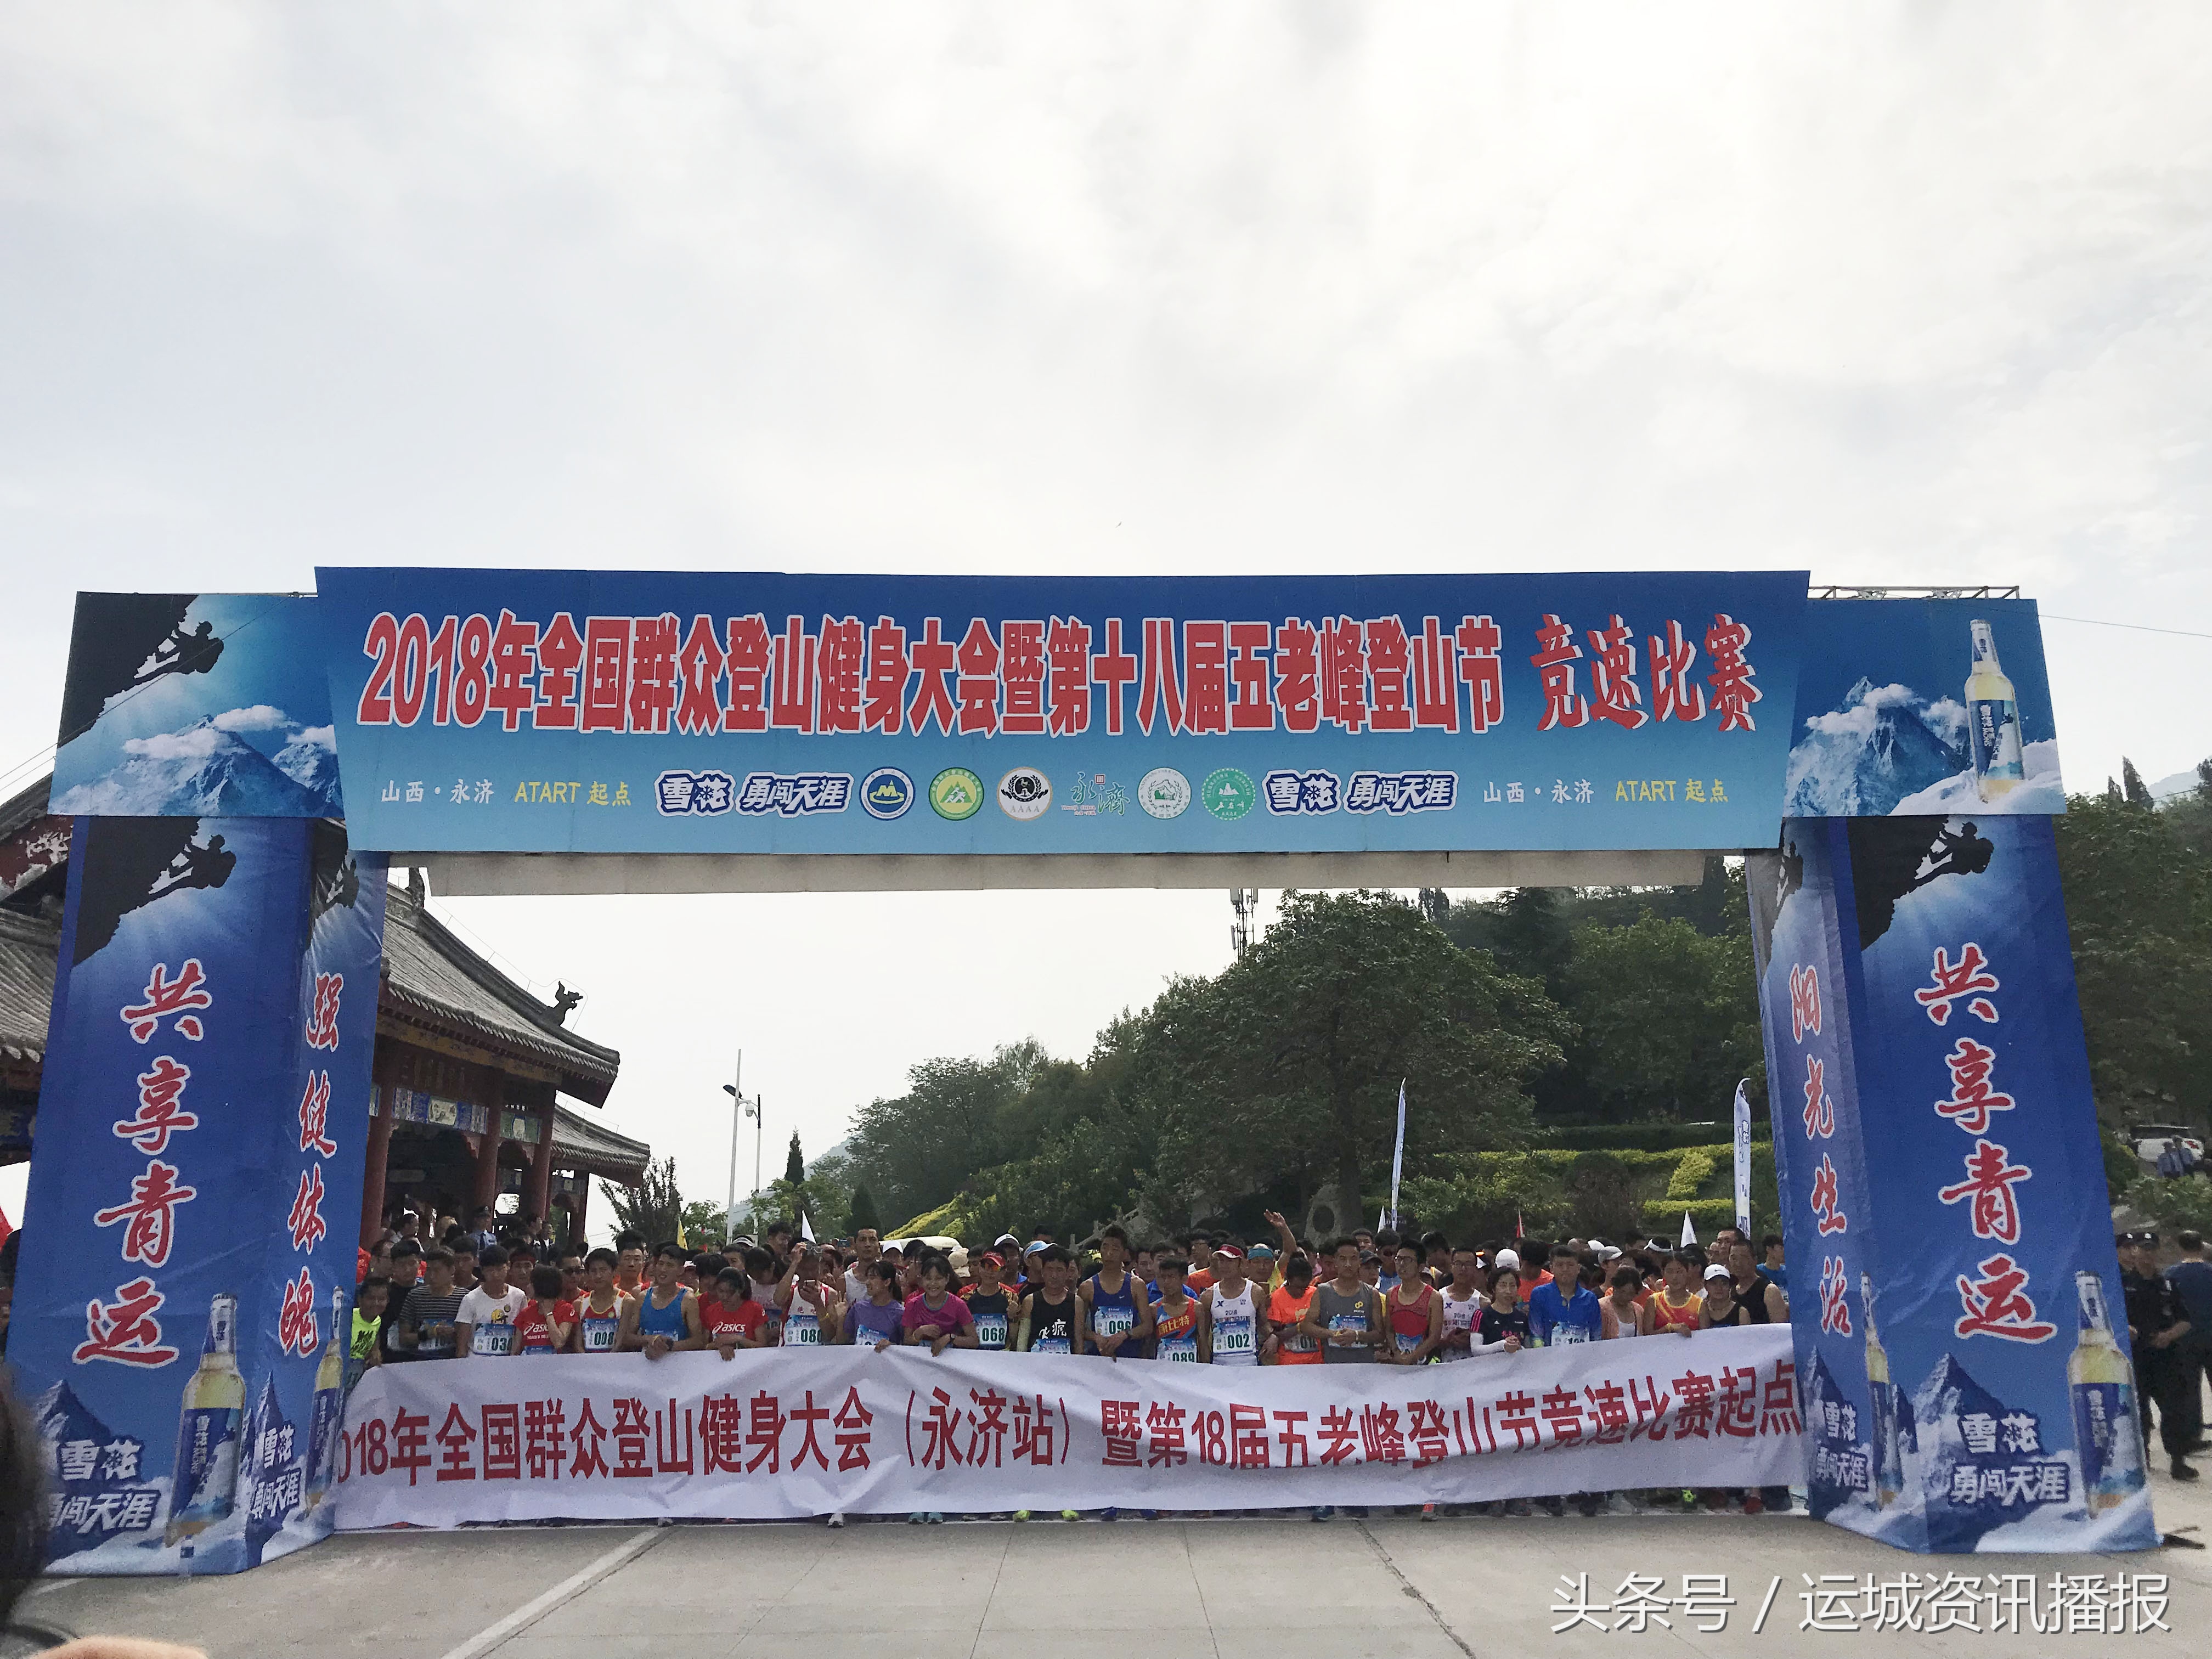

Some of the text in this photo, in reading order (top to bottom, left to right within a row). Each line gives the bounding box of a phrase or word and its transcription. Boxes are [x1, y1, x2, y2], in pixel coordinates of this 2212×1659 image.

[357, 608, 1763, 736] 2018年全国群众登山健身大会暨第十八届五老峰登山节 竞速比赛
[515, 780, 631, 806] ATART 起点
[657, 772, 733, 813] 雪花
[739, 772, 851, 814] 勇闯天涯
[1267, 772, 1340, 812] 雪花
[1347, 772, 1455, 813] 勇闯天涯
[1615, 778, 1729, 804] ATART 起点
[72, 958, 212, 1368] 共享青运
[1790, 963, 1853, 1338] 阳光生活
[1914, 942, 2058, 1344] 共享青运
[278, 972, 343, 1358] 强健体魄
[533, 1323, 549, 1333] asic
[721, 1323, 746, 1333] asics
[983, 1327, 1006, 1342] 068
[1227, 1333, 1250, 1348] 002
[263, 1425, 295, 1469] 雪花
[1961, 1413, 2040, 1453] 雪花
[60, 1439, 142, 1480] 雪花
[1952, 1464, 2067, 1506] 勇闯天涯
